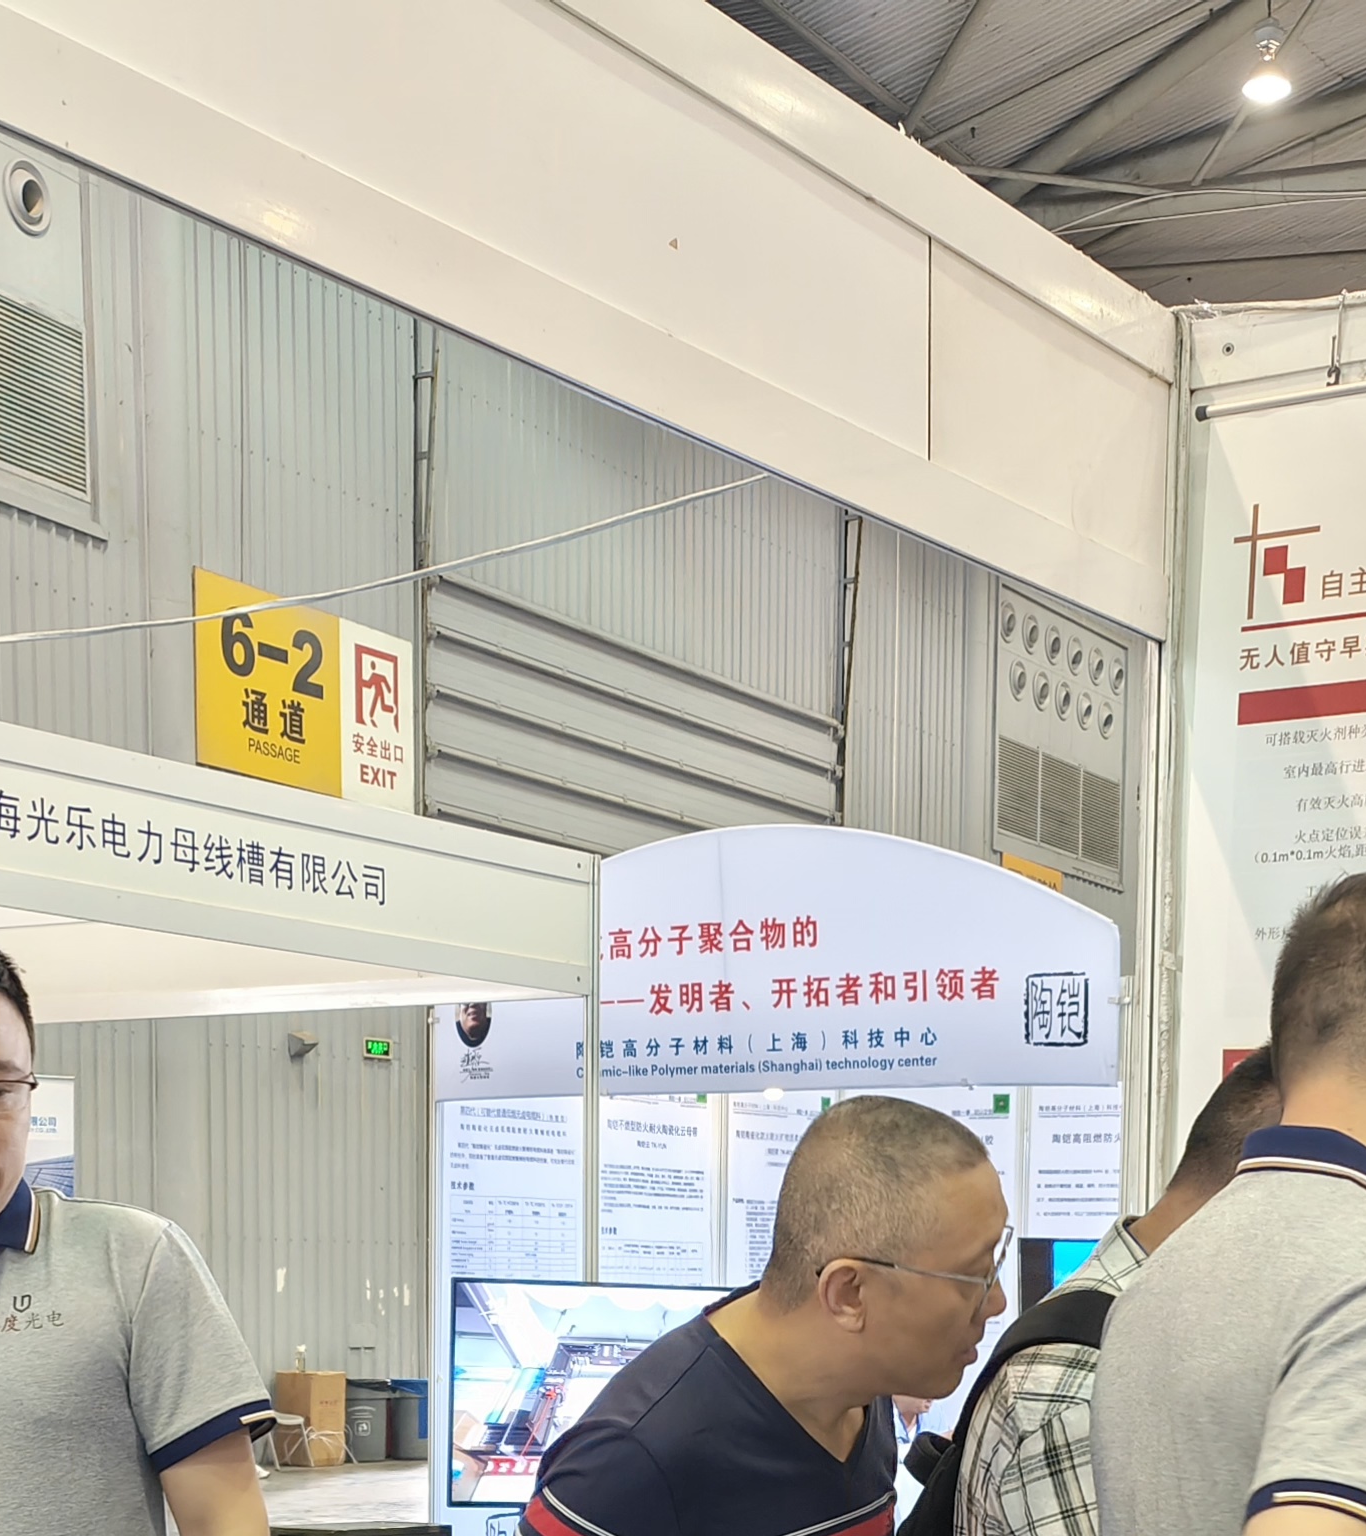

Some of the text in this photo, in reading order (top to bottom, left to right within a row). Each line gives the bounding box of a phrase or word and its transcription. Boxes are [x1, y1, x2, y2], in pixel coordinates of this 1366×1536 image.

[220, 605, 325, 700] 6-2
[241, 687, 306, 745] 通道
[248, 737, 301, 764] PASSAGE
[352, 732, 404, 764] 安全出口
[360, 763, 397, 790] EXIT
[600, 914, 819, 962] 高分子聚合物的
[651, 1063, 698, 1078] Polymer
[701, 1061, 755, 1075] materials
[758, 1058, 823, 1075] (Shanghai)
[825, 1056, 895, 1071] technology
[897, 1055, 938, 1068] center
